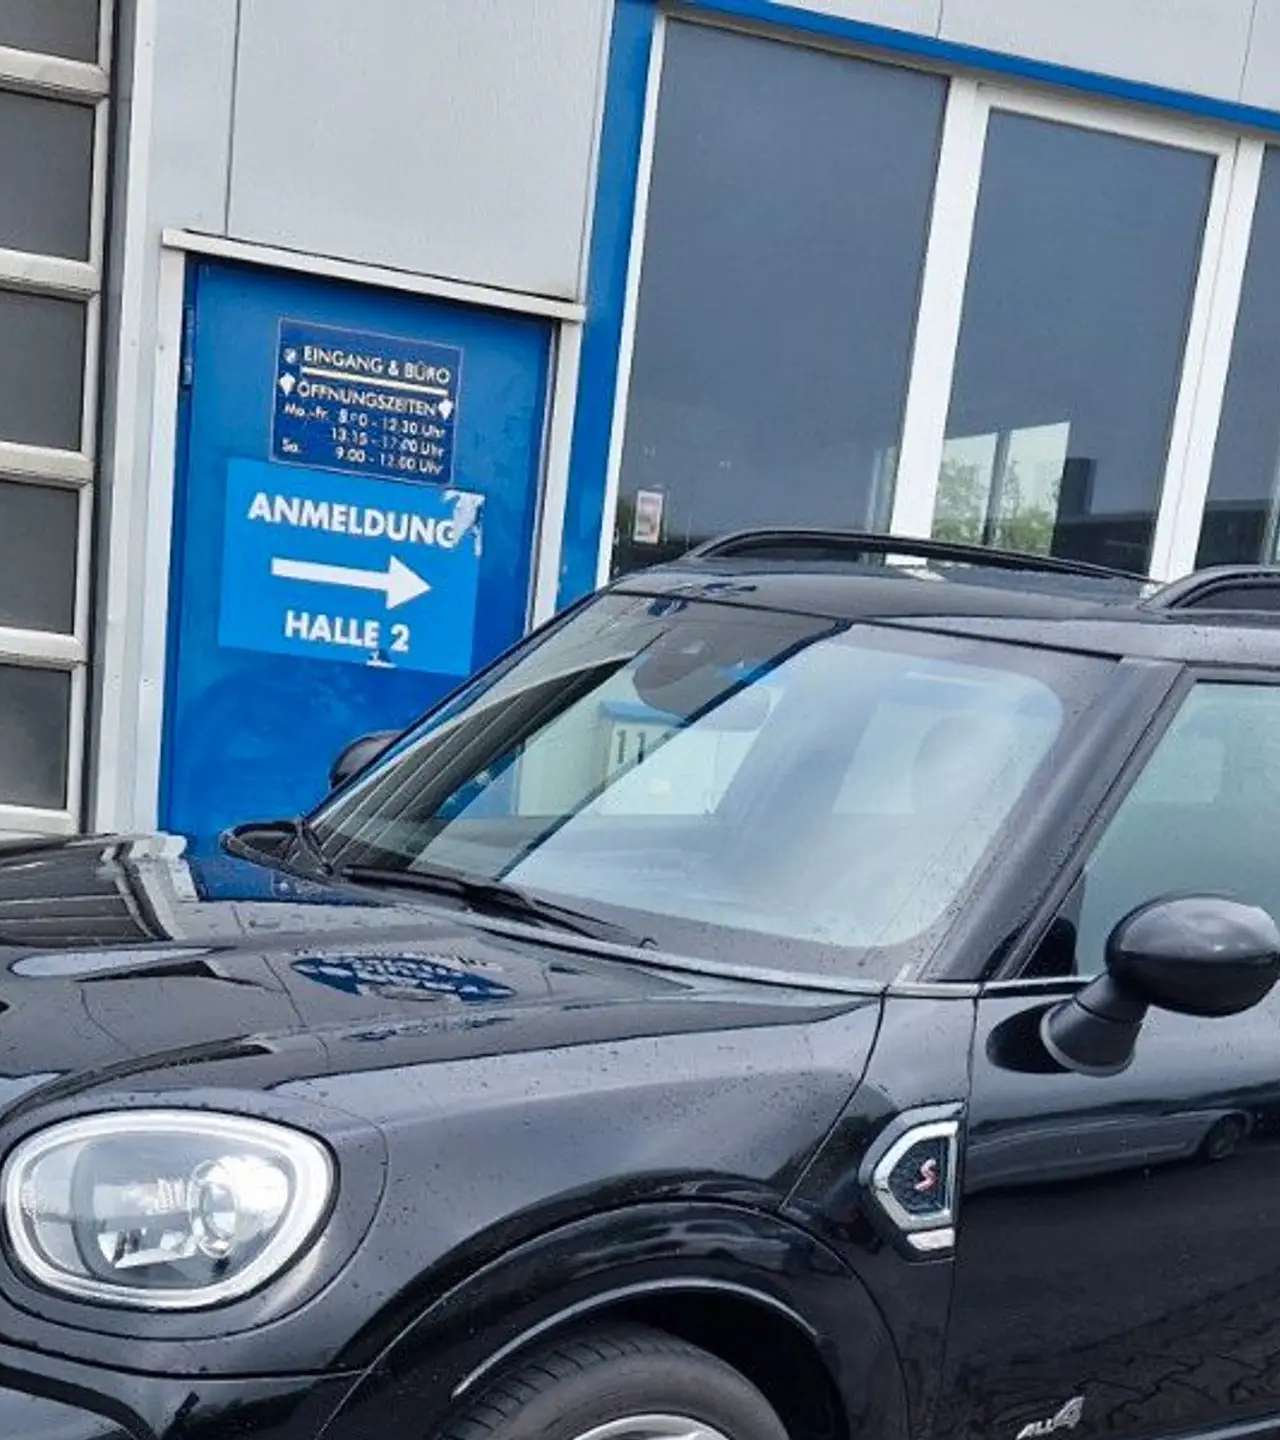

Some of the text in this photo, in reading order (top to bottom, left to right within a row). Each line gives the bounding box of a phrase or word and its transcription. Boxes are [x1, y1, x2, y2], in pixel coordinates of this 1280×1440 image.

[303, 345, 451, 385] EINGANG & BÜRO
[297, 378, 436, 416] ÖFFNUNGSZEITEN
[421, 424, 446, 438] Uhr
[421, 440, 445, 458] Uhr
[419, 457, 444, 474] Uhr
[248, 492, 463, 549] ANMELDUNG
[285, 609, 410, 652] HALLE 2
